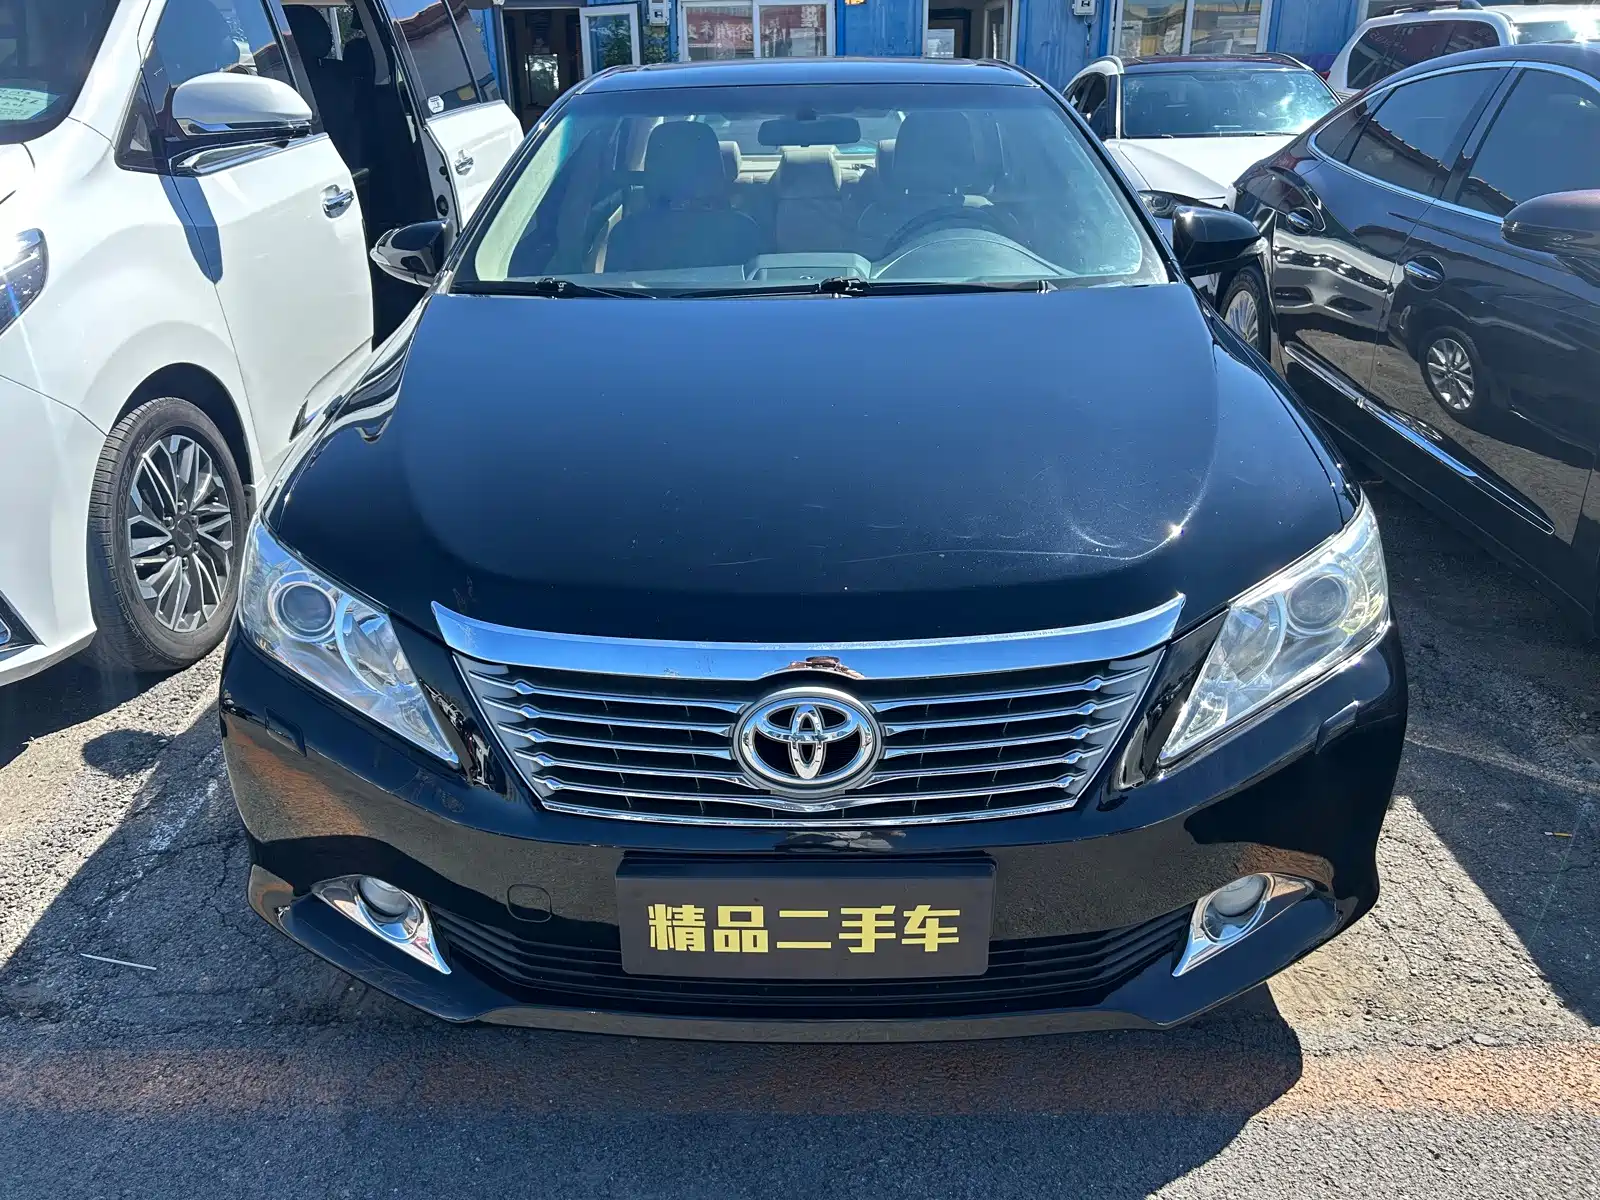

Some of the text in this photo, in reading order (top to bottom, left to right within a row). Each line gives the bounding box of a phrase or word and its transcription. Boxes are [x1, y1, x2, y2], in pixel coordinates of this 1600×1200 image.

[648, 904, 960, 953] 精品二手车
